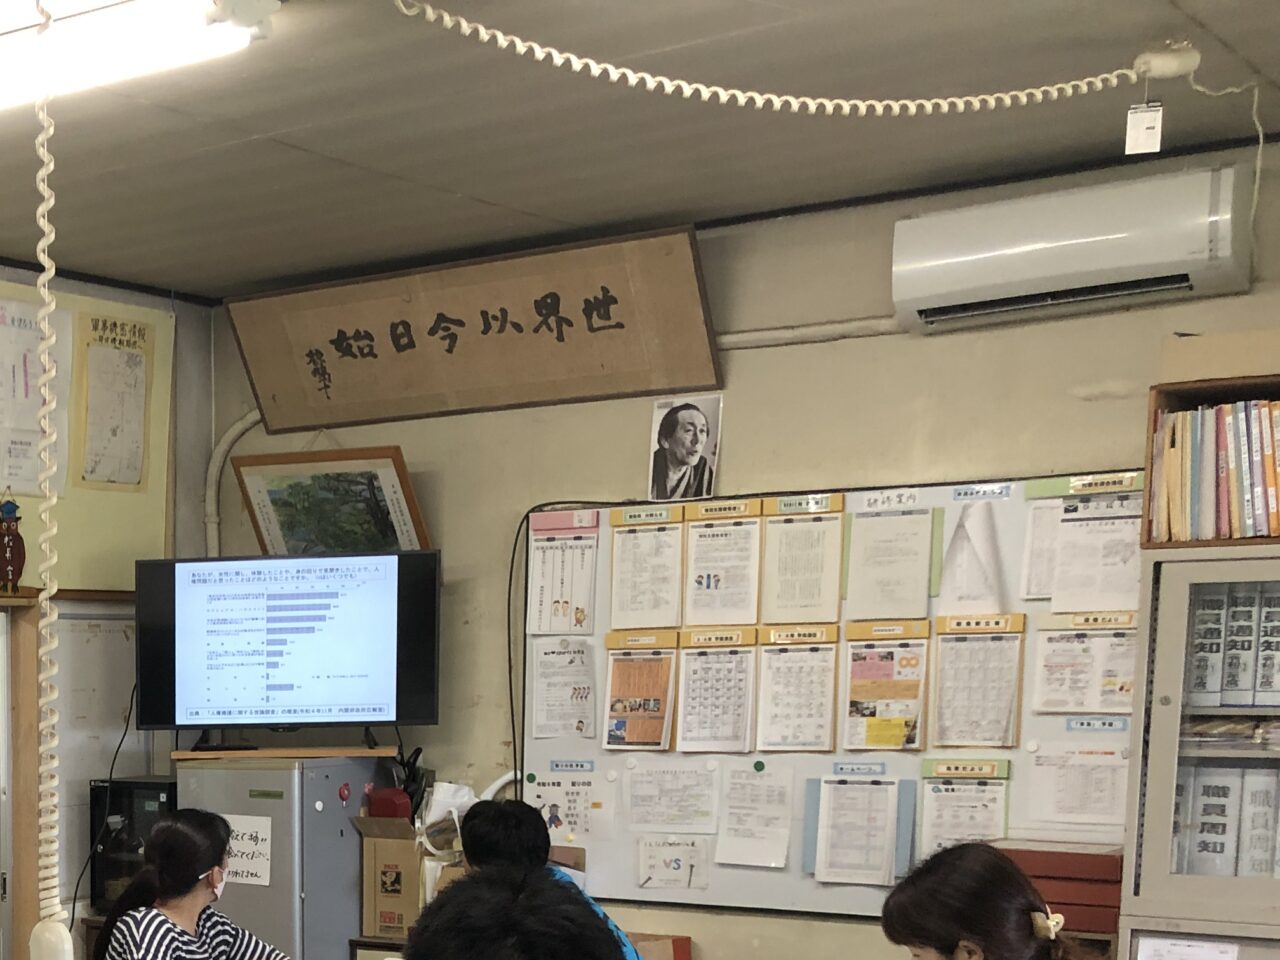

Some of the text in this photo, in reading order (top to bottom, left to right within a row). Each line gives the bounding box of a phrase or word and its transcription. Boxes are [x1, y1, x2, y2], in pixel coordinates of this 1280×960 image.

[1197, 785, 1231, 854] 職員周知
[1249, 790, 1271, 873] 職員周知
[663, 858, 682, 871] VS
